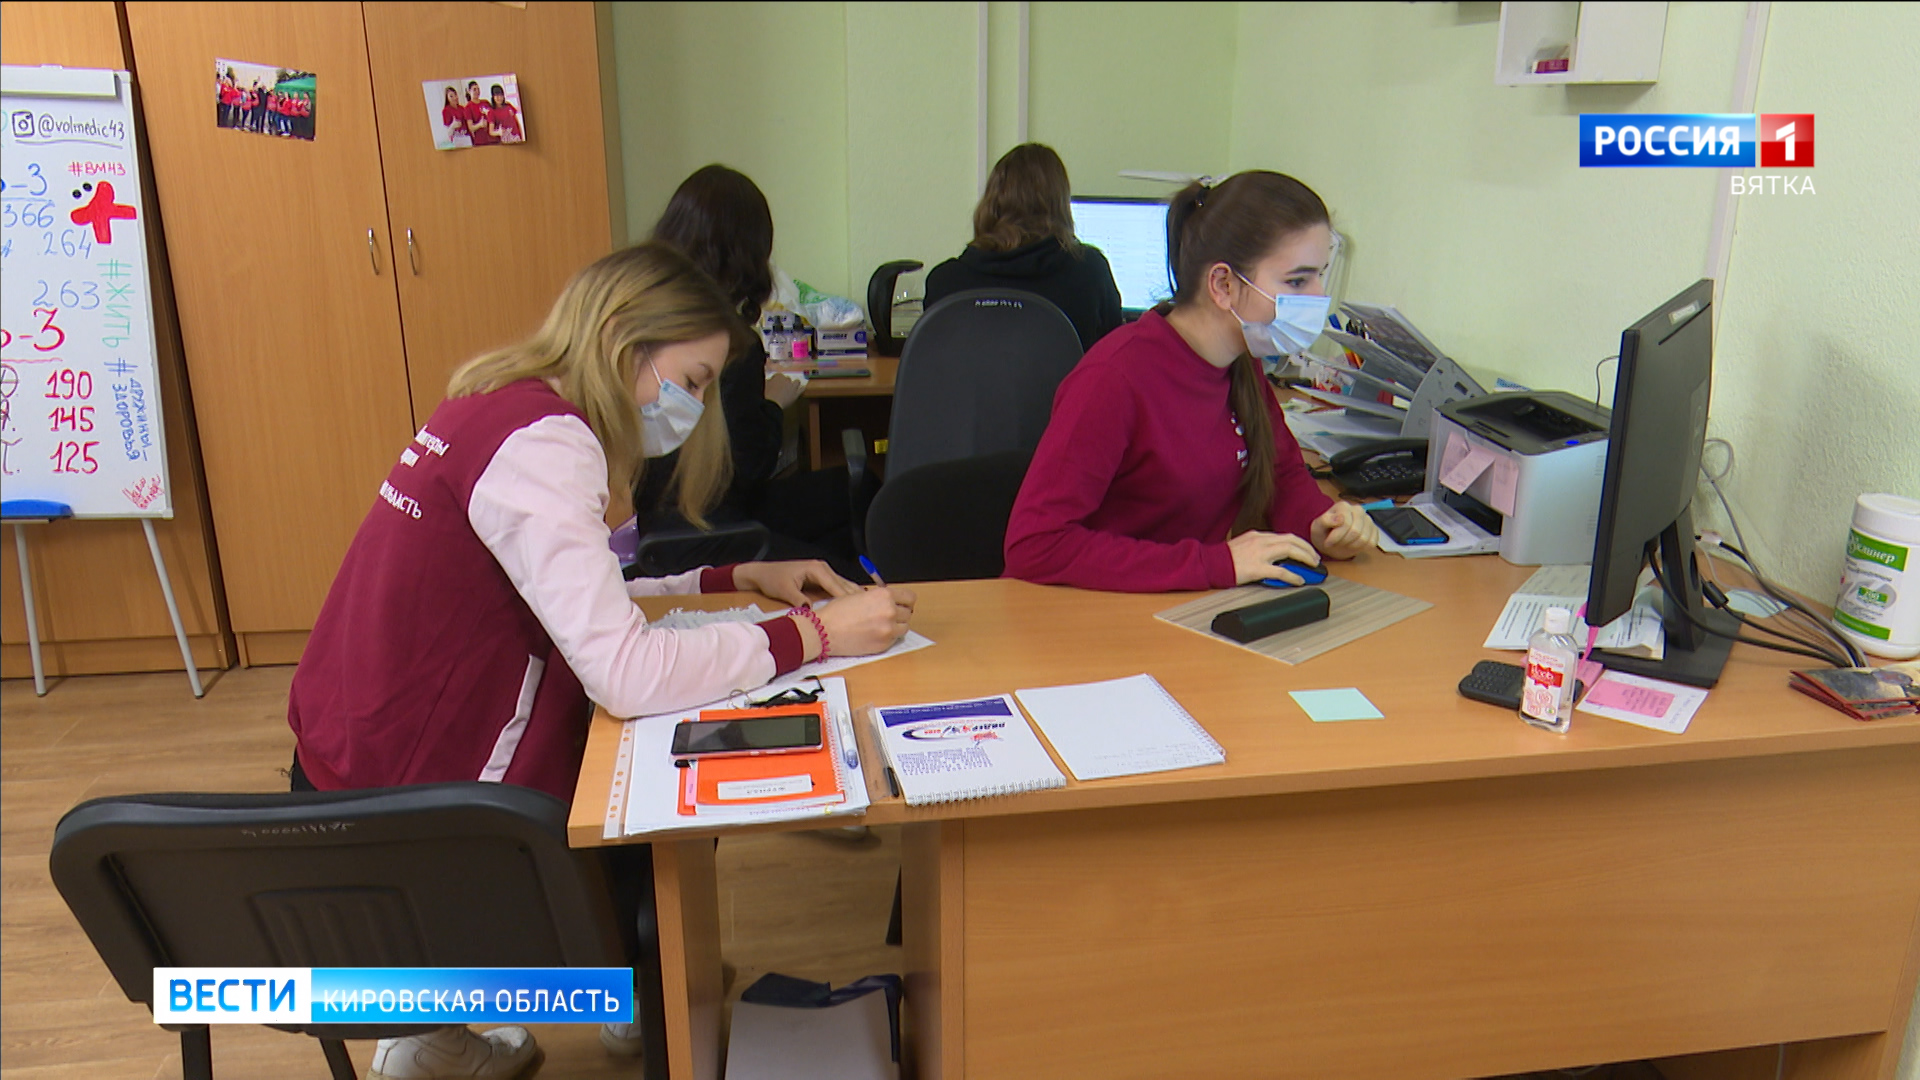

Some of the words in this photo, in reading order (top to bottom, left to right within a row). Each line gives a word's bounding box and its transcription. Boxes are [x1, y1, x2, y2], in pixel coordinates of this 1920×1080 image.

[38, 113, 125, 140] @volmedic43
[43, 229, 92, 259] 264
[32, 280, 101, 310] 263
[44, 368, 94, 400] 190
[47, 405, 96, 433] 145
[49, 440, 101, 475] 125
